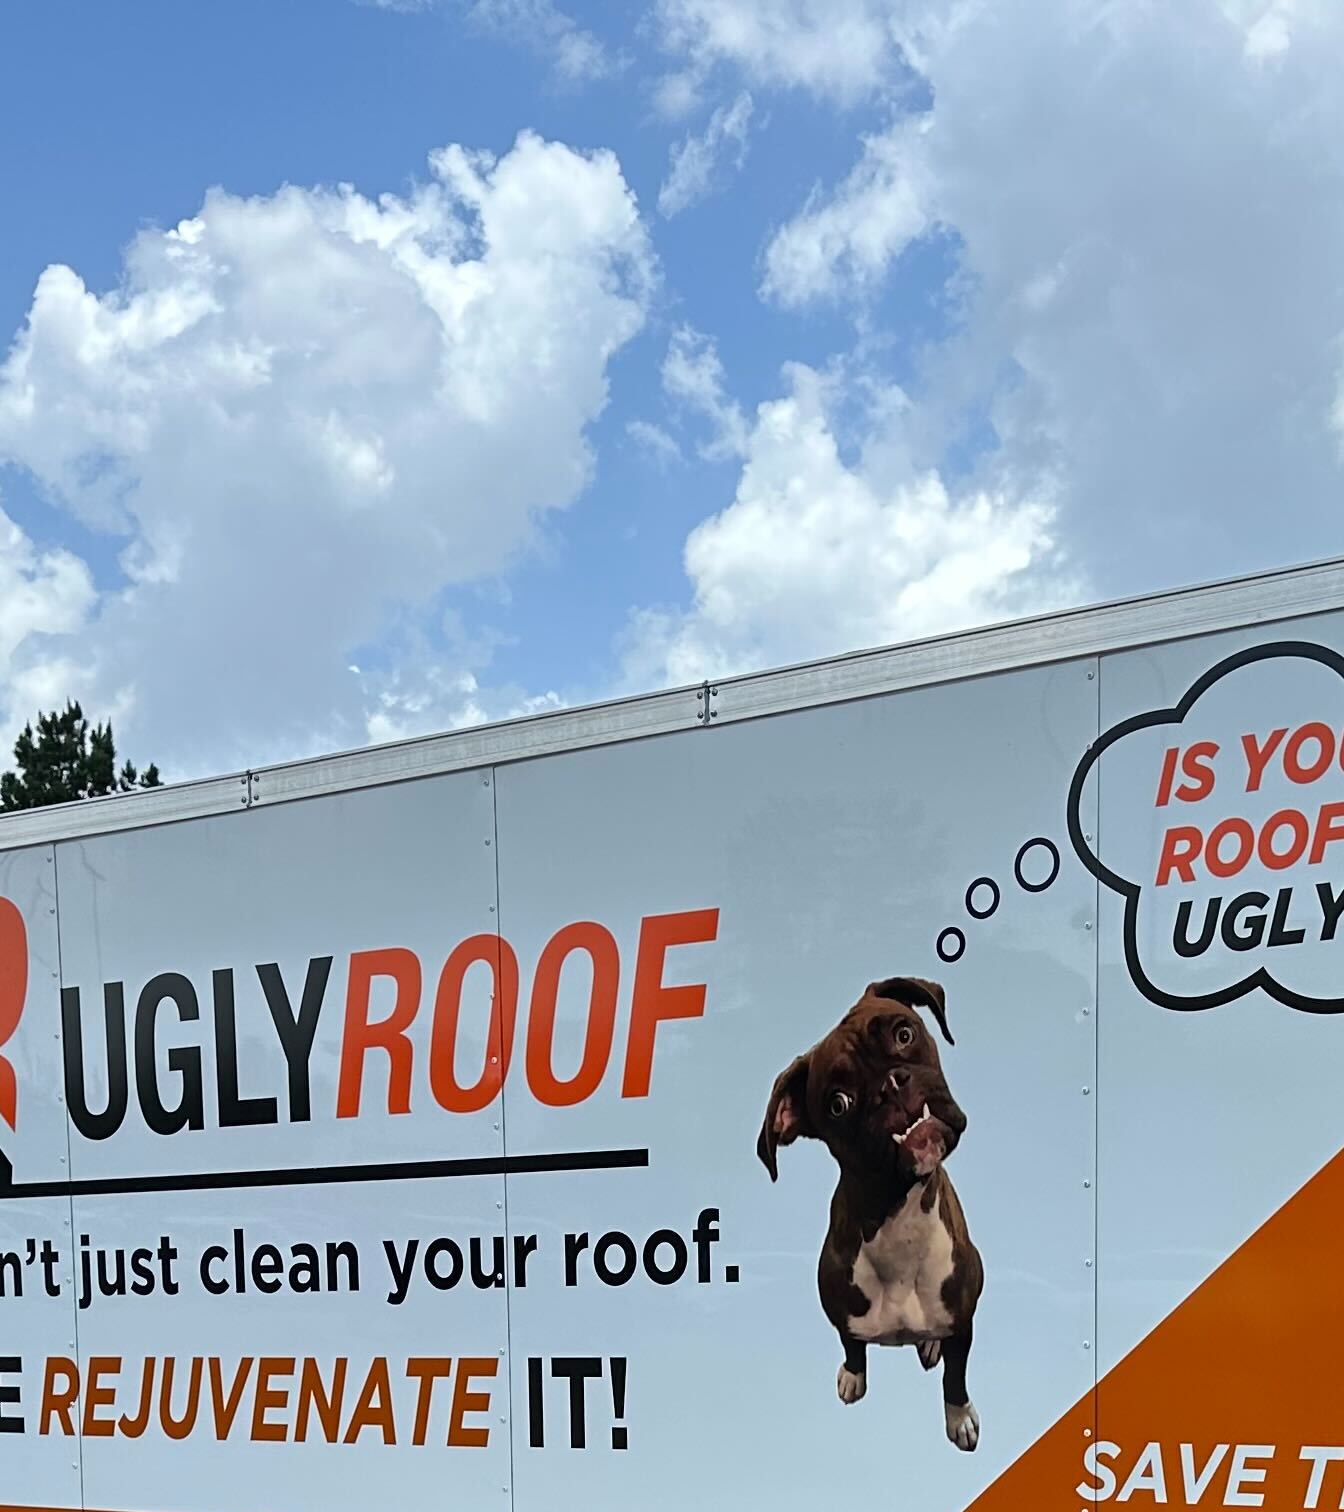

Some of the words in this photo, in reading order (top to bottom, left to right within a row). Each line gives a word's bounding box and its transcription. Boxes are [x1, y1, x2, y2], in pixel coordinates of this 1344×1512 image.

[1155, 742, 1220, 808] IS
[61, 908, 720, 1140] UGLYROOF
[79, 1234, 178, 1310] just
[199, 1229, 360, 1294] clean
[383, 1232, 538, 1306] your
[564, 1208, 741, 1288] roof.
[38, 1356, 499, 1448] REJUVENATE
[526, 1356, 629, 1450] IT!
[1075, 1441, 1275, 1507] SAVE
